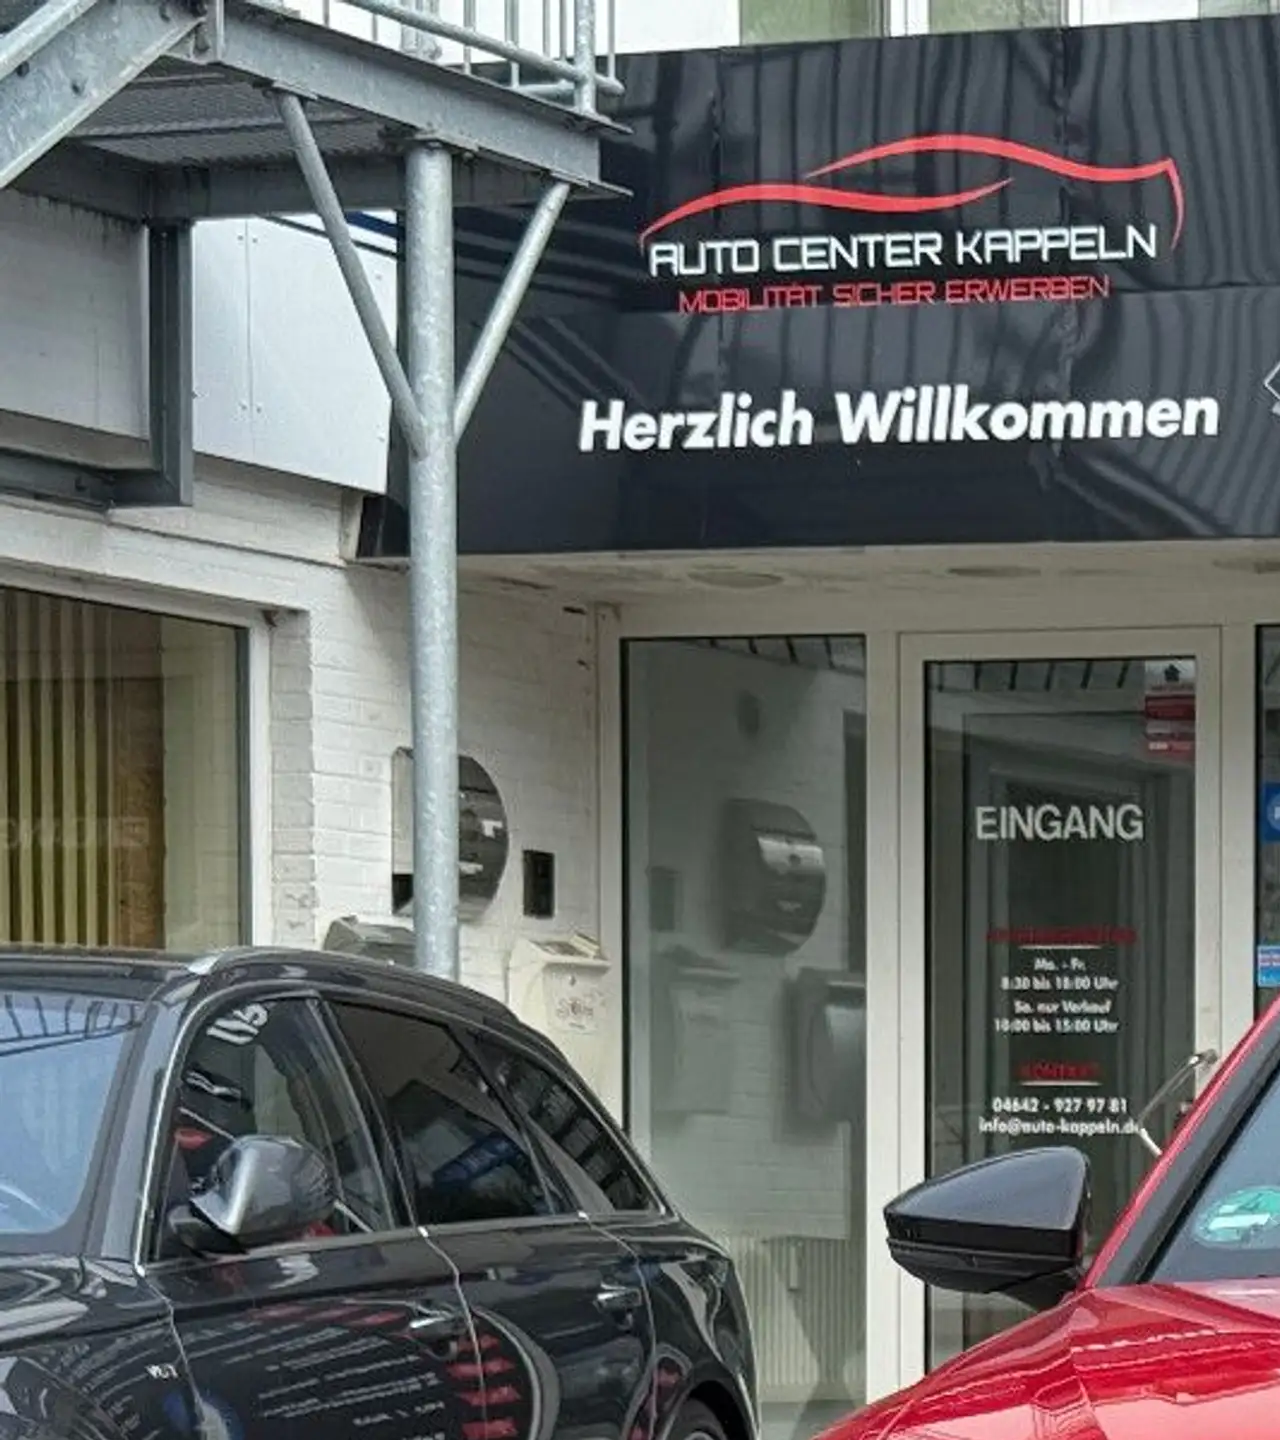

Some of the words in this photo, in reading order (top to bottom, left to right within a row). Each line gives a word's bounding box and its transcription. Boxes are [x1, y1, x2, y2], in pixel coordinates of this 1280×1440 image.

[650, 239, 760, 277] AUTO
[772, 231, 943, 272] CENTER
[956, 223, 1157, 265] KAPPELN
[833, 277, 938, 308] SICHER
[945, 274, 1110, 304] ERWERBEN
[579, 389, 814, 452] Herzlich
[834, 383, 1219, 444] Willkommen
[975, 803, 1144, 841] EINGANG
[1032, 974, 1051, 990] bis
[1094, 974, 1119, 990] Uhr
[1032, 1018, 1051, 1033] bis
[1094, 1018, 1119, 1033] Uhr
[1053, 1097, 1082, 1113] 927
[1085, 1097, 1106, 1113] 97
